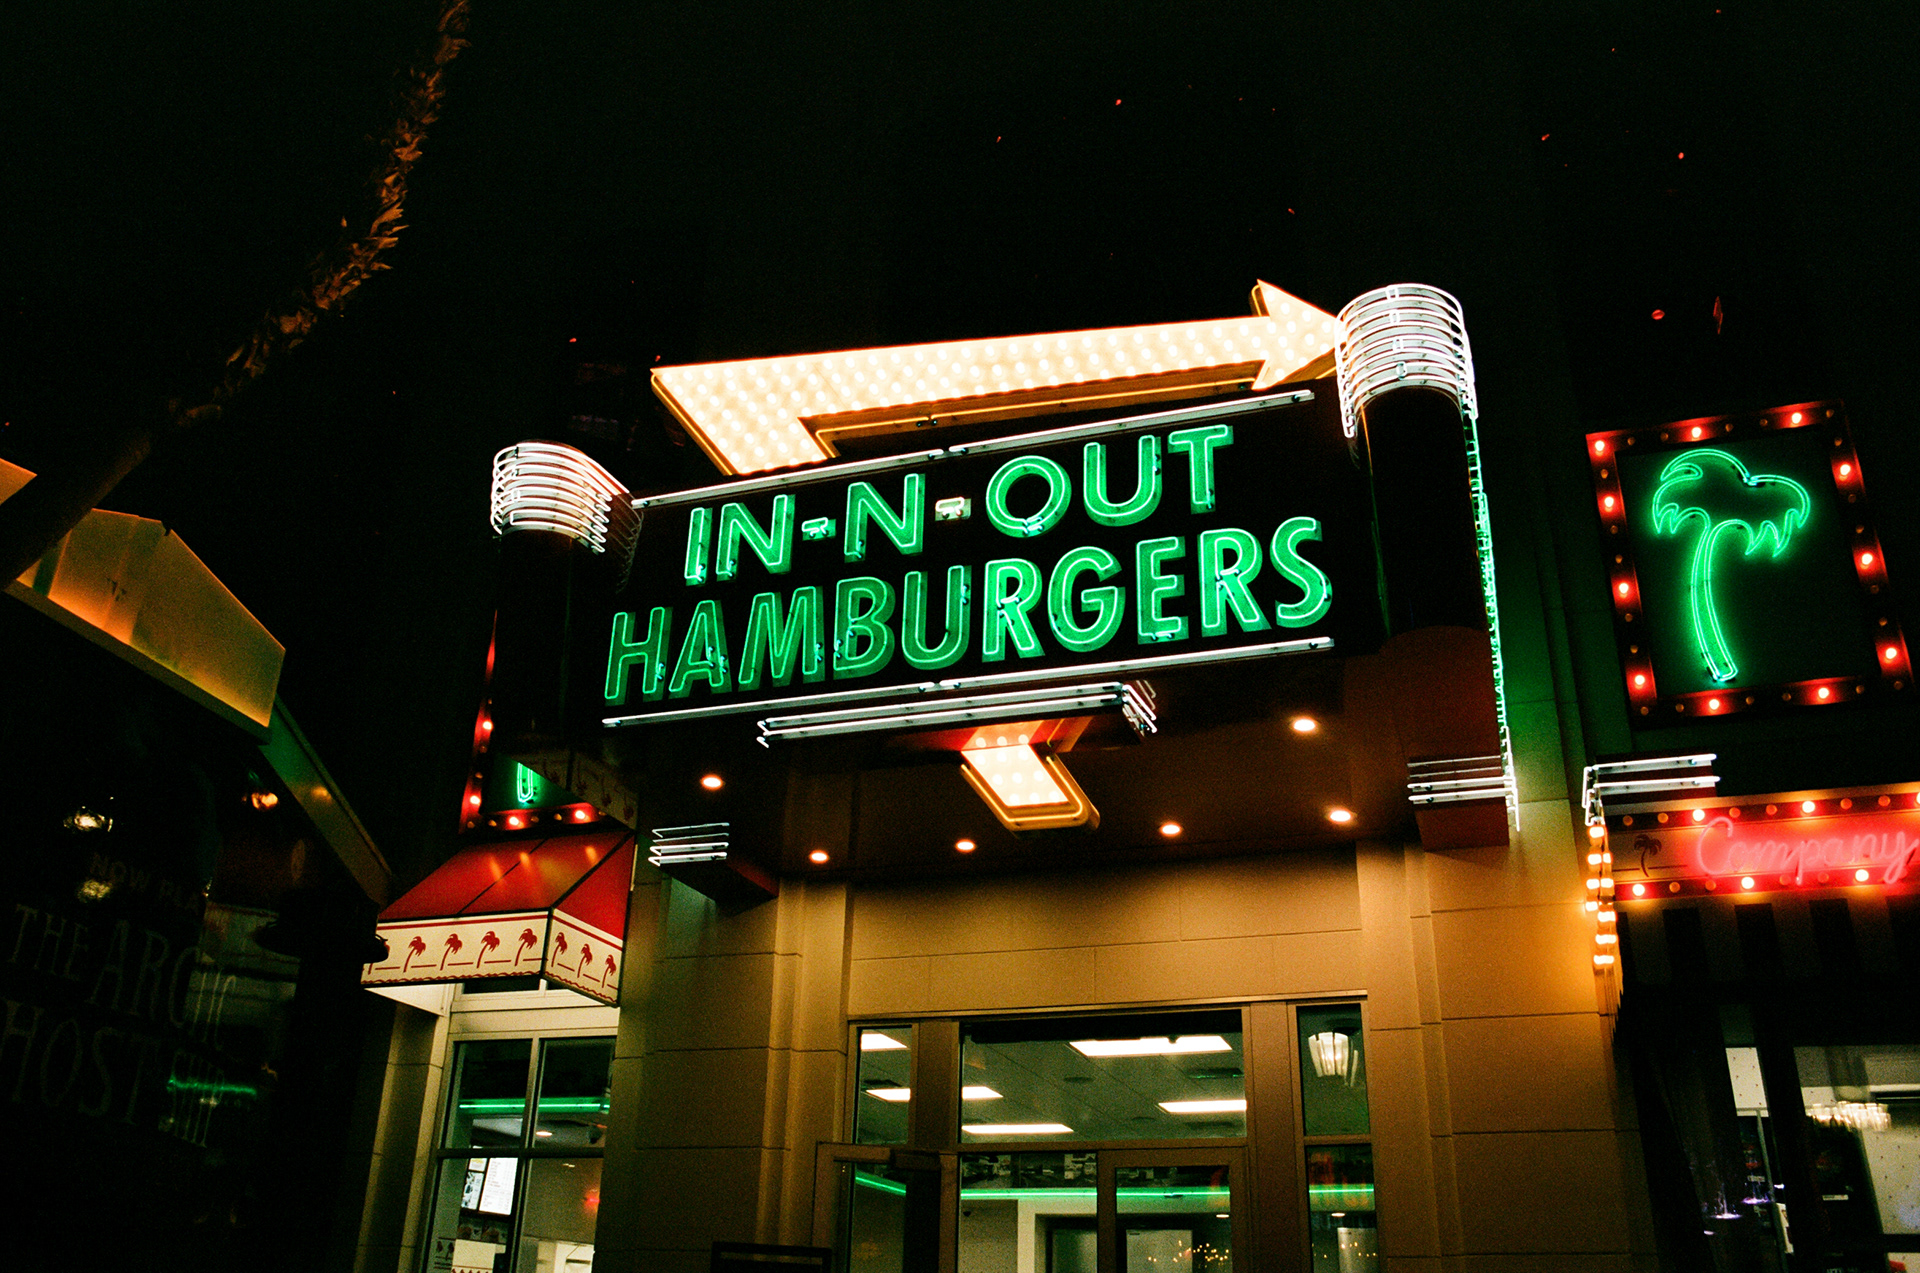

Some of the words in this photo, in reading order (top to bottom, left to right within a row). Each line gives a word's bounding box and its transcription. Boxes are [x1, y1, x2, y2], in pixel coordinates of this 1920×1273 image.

[685, 424, 1234, 586] IN-N-OUT
[603, 517, 1333, 706] HAMBURGERS
[1696, 816, 1919, 885] Company
[8, 902, 90, 982] THE
